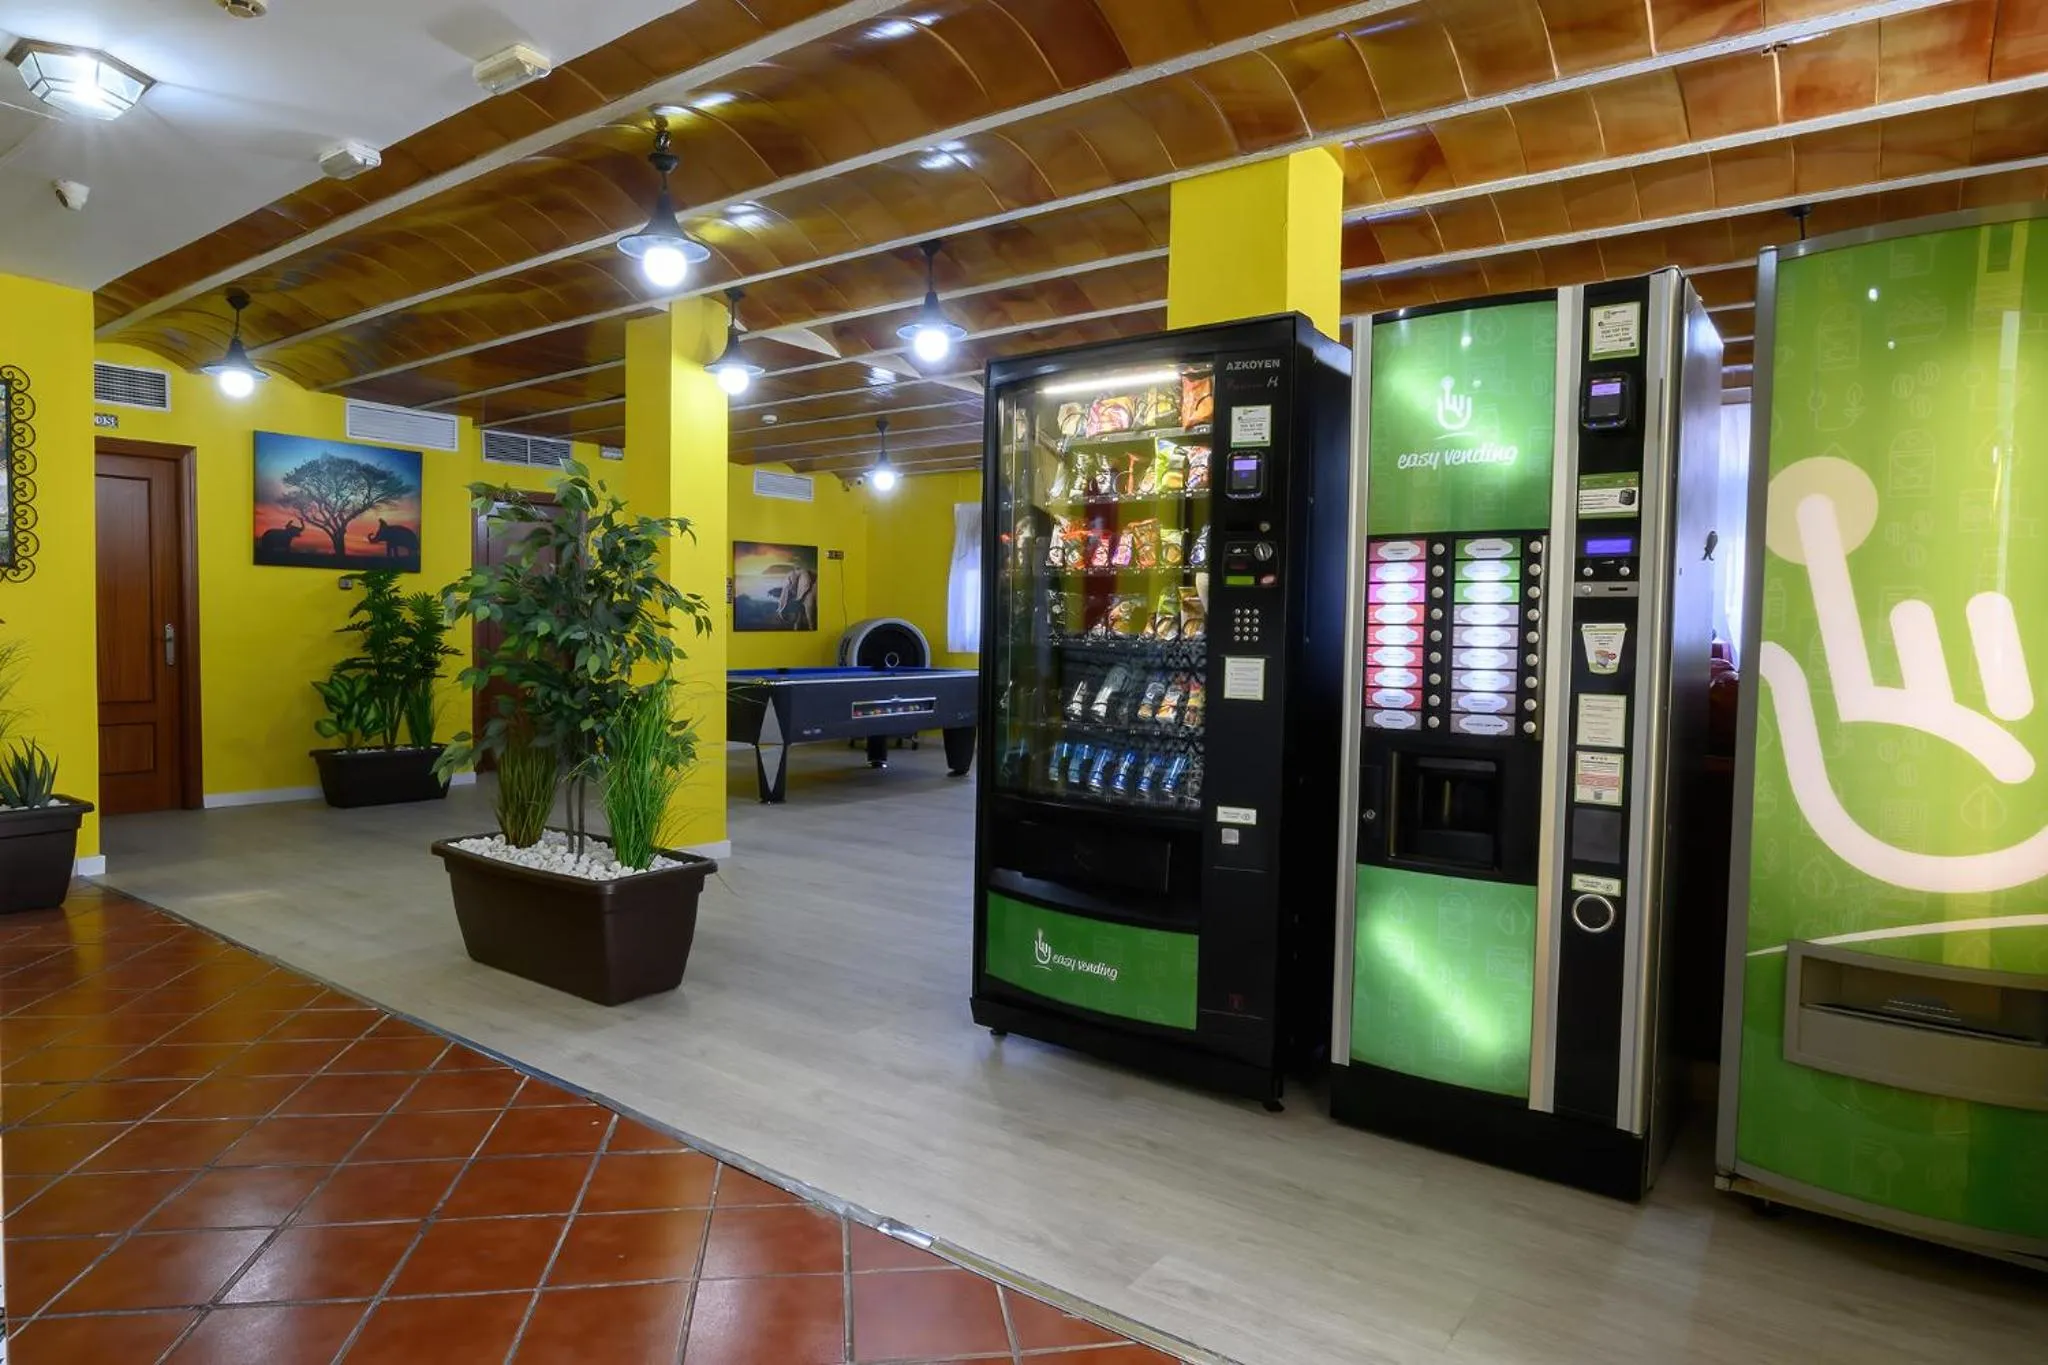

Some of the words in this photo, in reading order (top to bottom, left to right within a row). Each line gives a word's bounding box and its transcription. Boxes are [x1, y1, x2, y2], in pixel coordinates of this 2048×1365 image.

[1226, 359, 1280, 371] AZKOYEN
[1397, 450, 1440, 470] easy
[1444, 442, 1518, 467] vending
[1052, 954, 1075, 971] easy
[1078, 960, 1118, 981] vending
